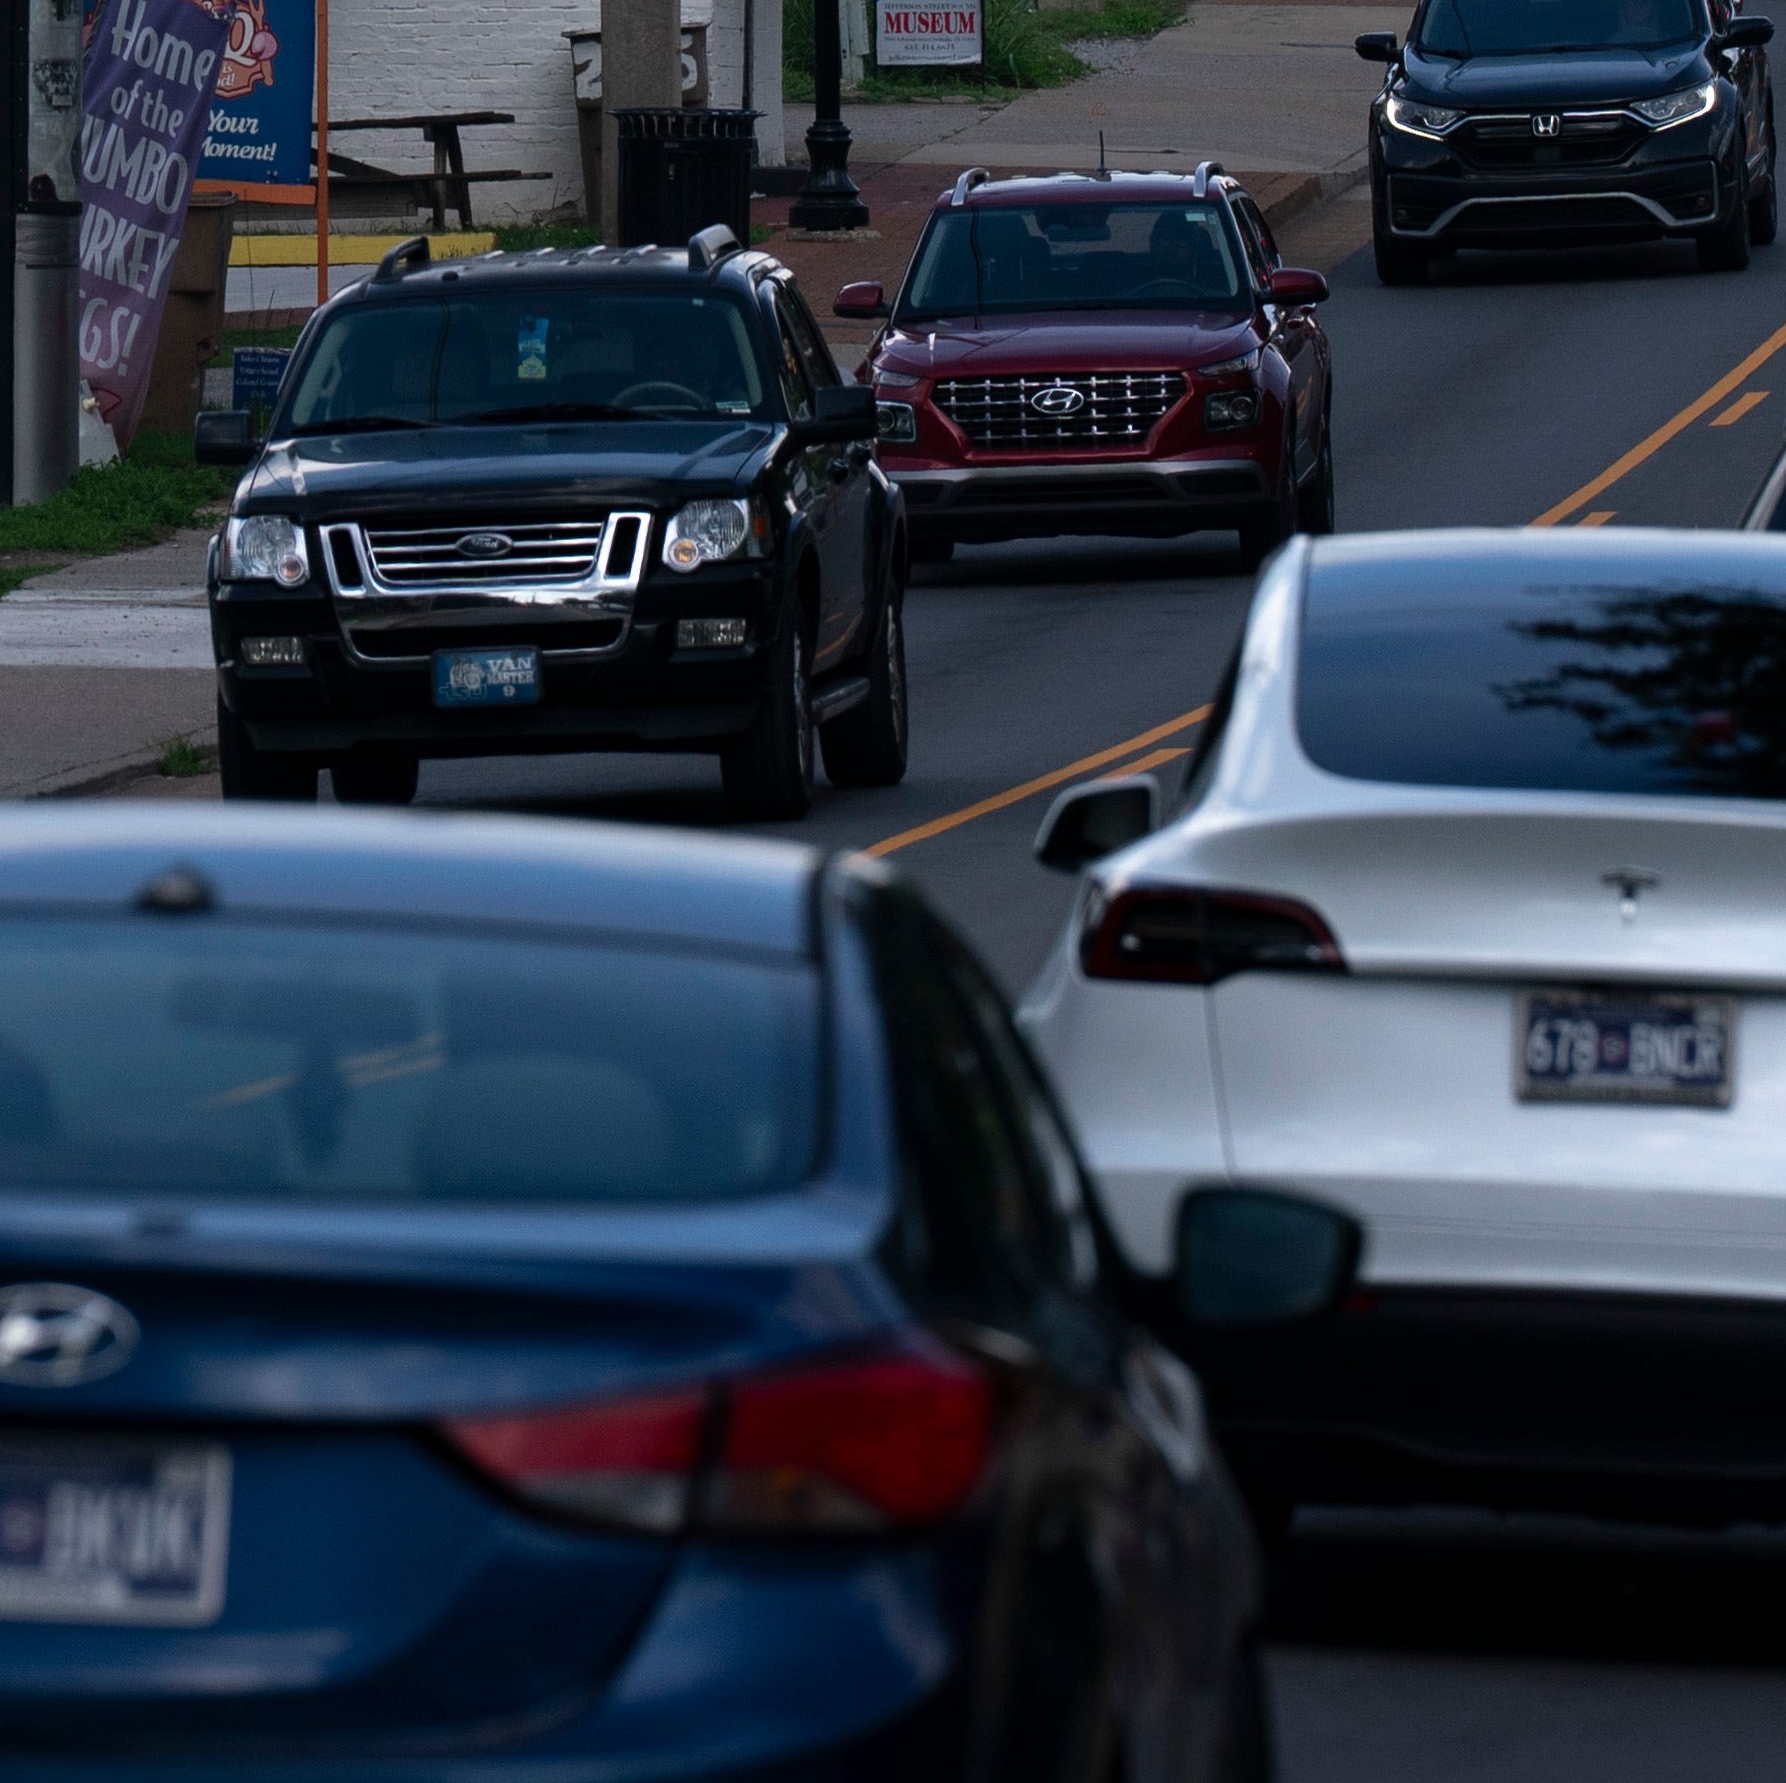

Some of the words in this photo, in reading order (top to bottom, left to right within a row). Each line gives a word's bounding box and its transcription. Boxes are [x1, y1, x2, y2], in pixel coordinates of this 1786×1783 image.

[885, 11, 975, 34] MUSEUM
[111, 79, 143, 120] of
[140, 89, 183, 138] the
[208, 109, 259, 136] Your
[79, 203, 180, 300] RKEY
[79, 290, 141, 377] GS!
[486, 657, 532, 672] VAN
